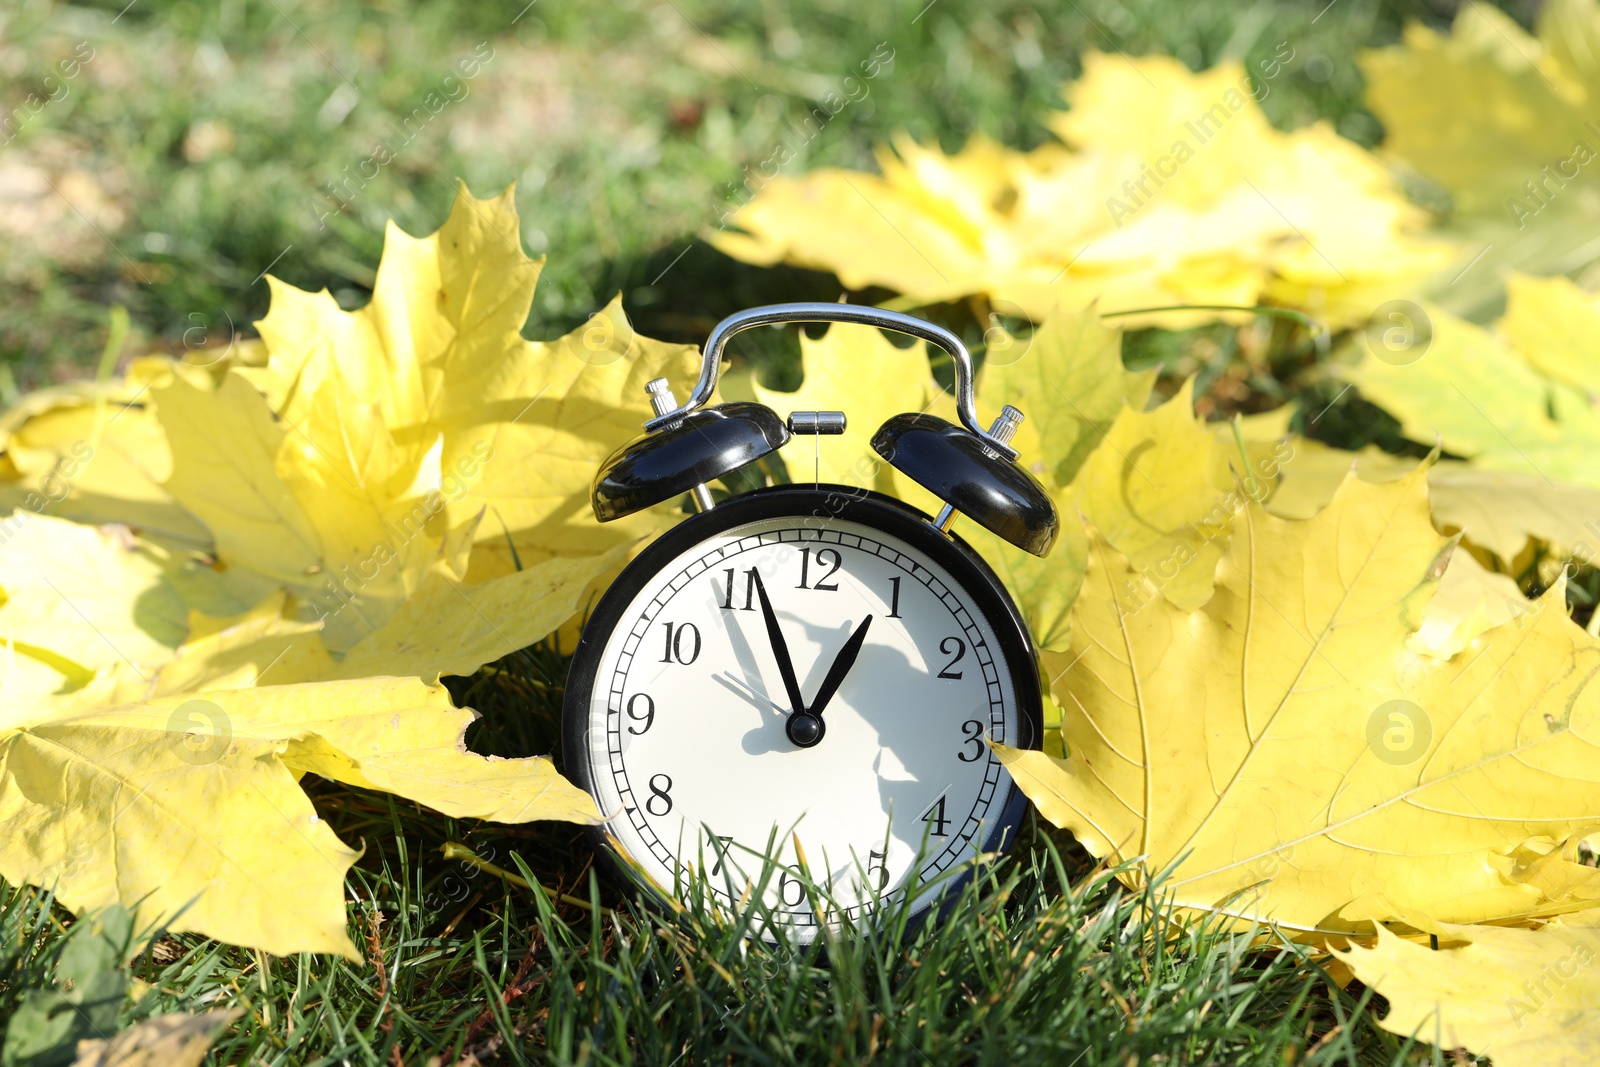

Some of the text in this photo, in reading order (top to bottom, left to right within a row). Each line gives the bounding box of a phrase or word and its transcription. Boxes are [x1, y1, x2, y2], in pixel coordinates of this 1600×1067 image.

[719, 567, 757, 612] 11
[794, 547, 843, 592] 12
[885, 576, 902, 619] 1
[658, 621, 702, 666] 10
[937, 636, 967, 680] 2
[626, 693, 655, 735] 9
[957, 720, 985, 763] 3
[645, 773, 674, 817] 8
[921, 794, 952, 838] 4
[706, 835, 734, 876] 7
[862, 849, 890, 893] 5
[778, 864, 806, 907] 6
